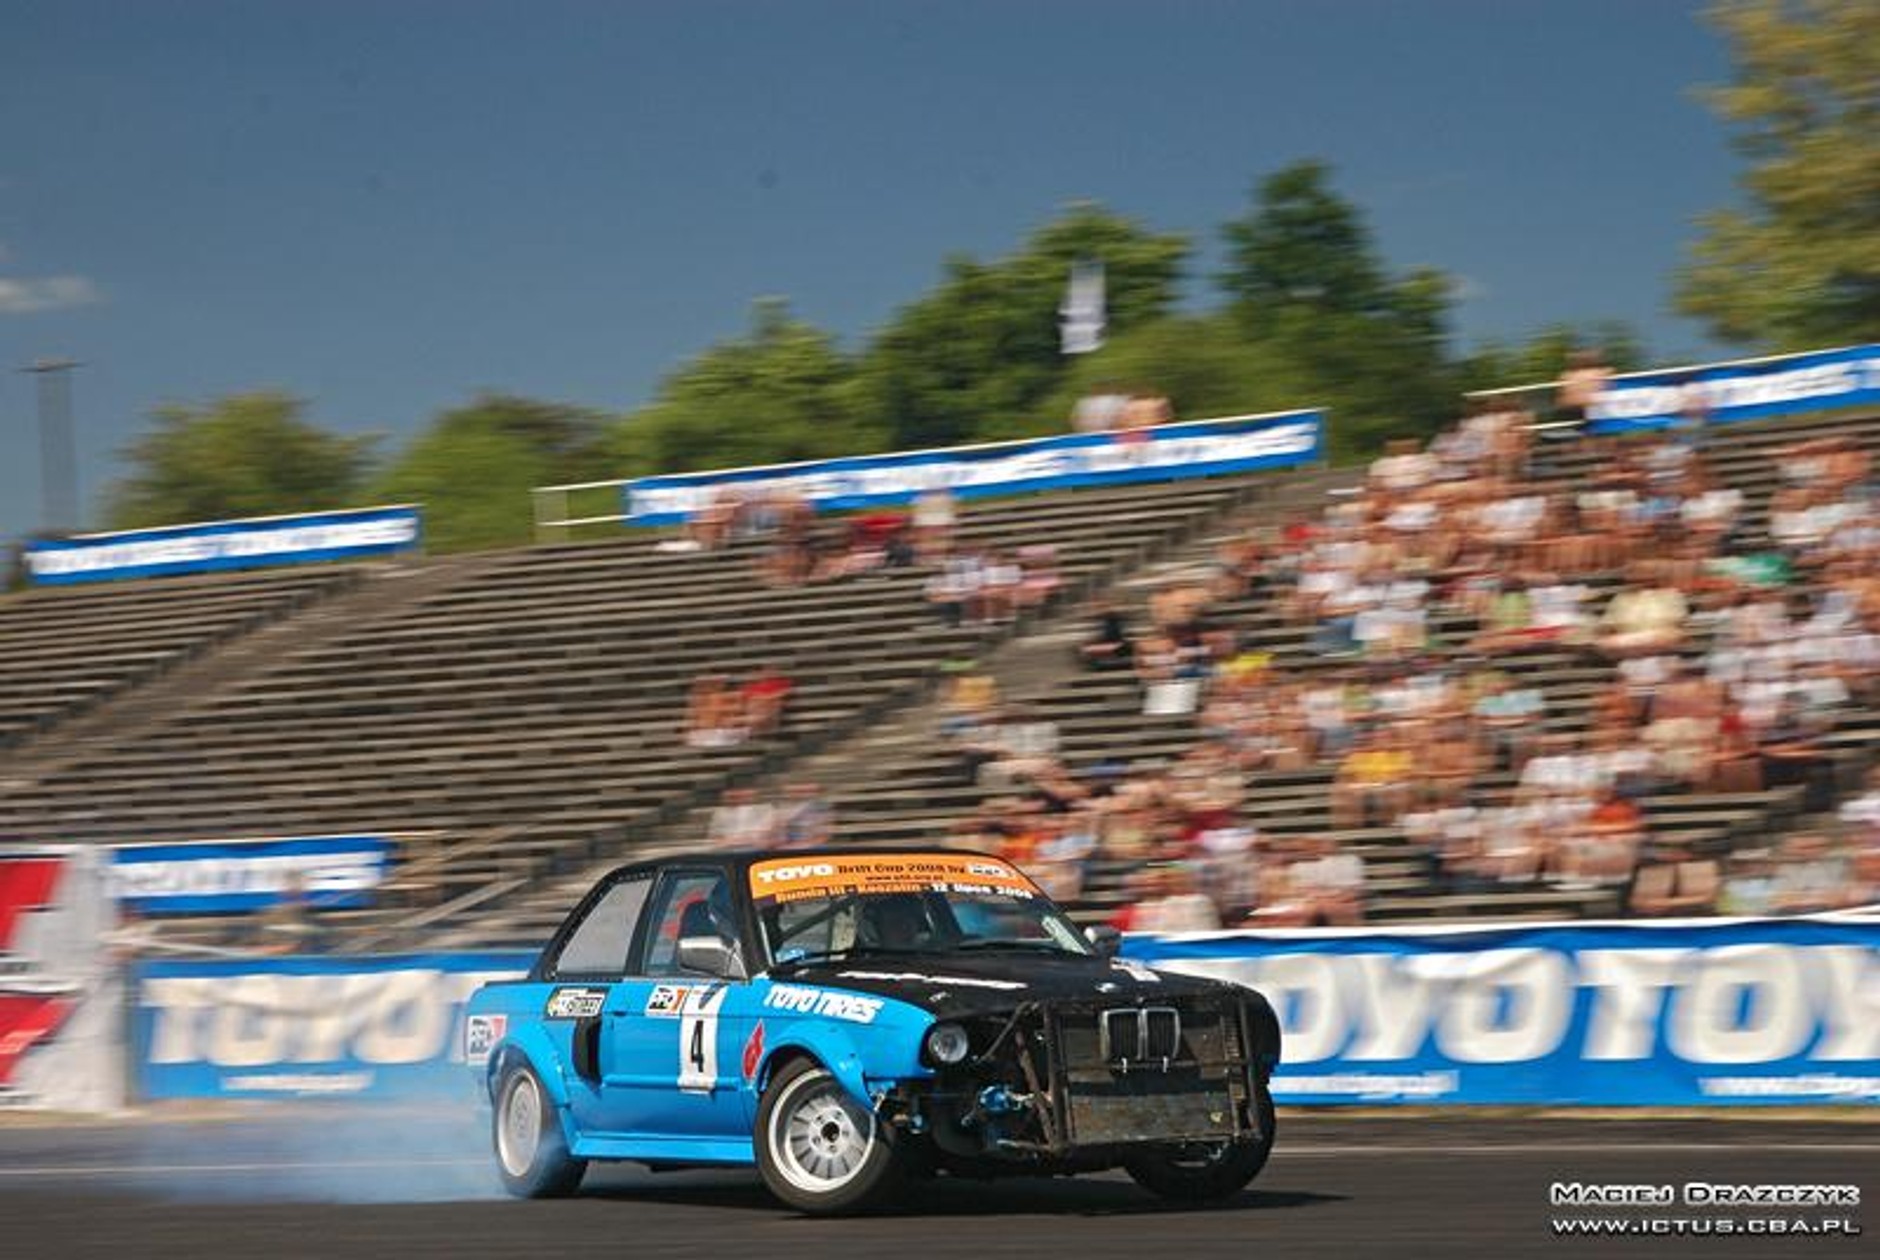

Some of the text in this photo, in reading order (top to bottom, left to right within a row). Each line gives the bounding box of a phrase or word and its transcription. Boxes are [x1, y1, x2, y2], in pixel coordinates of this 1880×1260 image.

[756, 864, 833, 883] TOYO
[142, 970, 449, 1066] TOYO
[763, 984, 885, 1023] TOYO TIRES
[691, 1019, 704, 1073] 4
